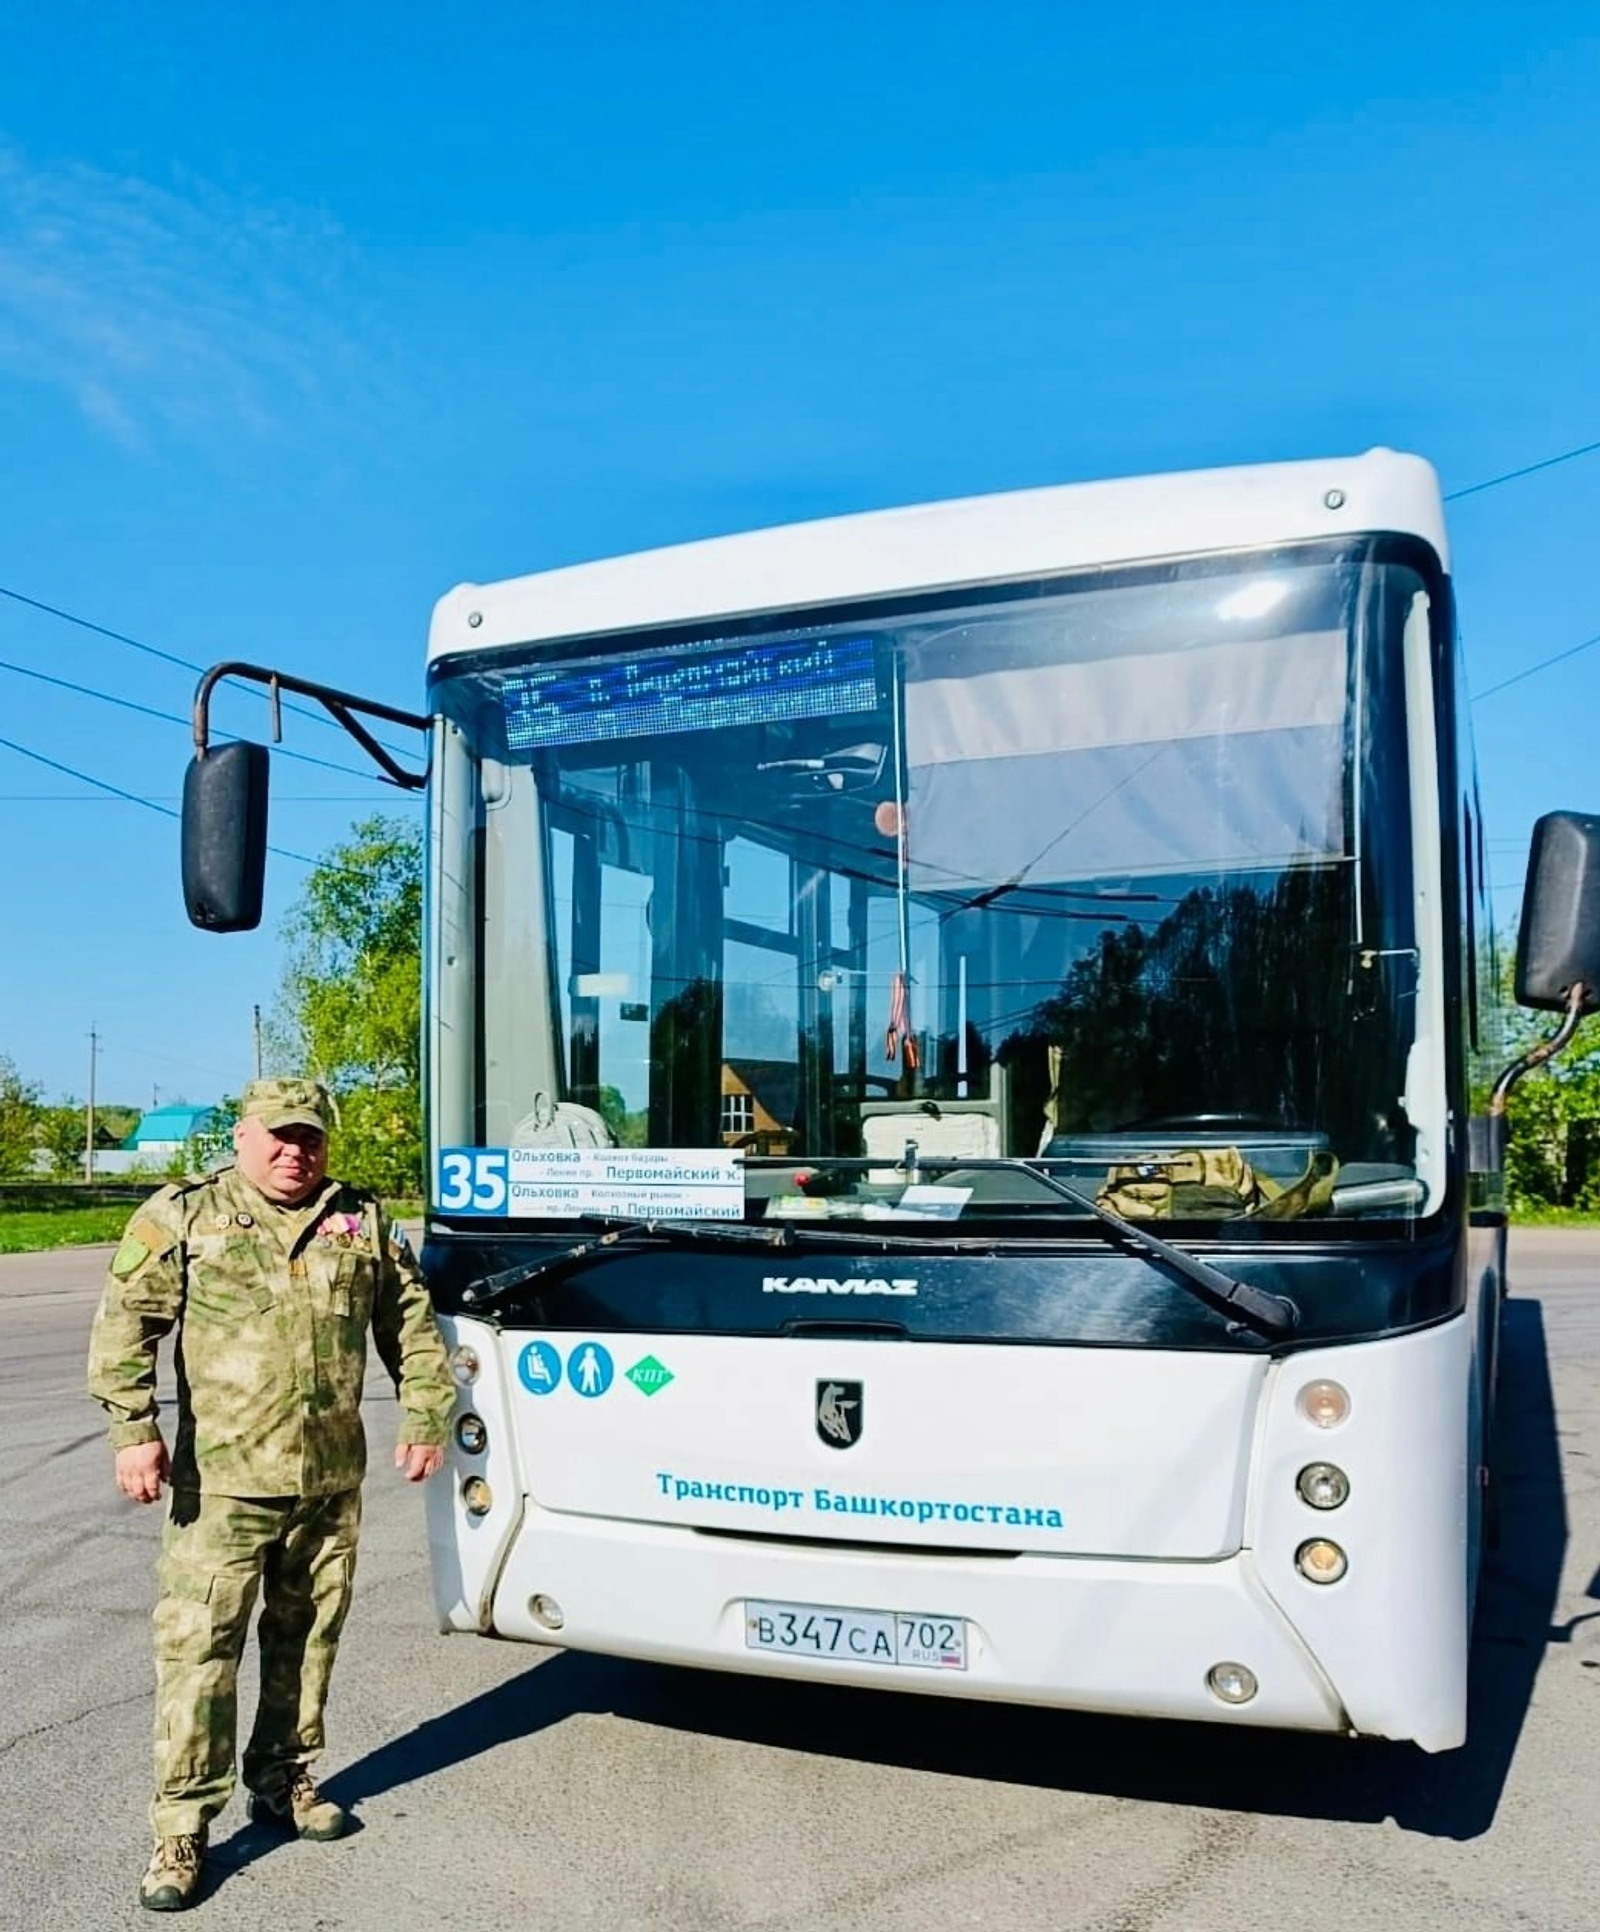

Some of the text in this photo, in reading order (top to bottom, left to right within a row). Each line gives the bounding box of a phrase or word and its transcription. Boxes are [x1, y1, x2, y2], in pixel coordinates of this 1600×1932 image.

[512, 1150, 581, 1163] Ольховка
[607, 1166, 720, 1181] Первомайский
[441, 1154, 506, 1210] 35
[512, 1185, 579, 1198] Ольховка
[628, 1203, 740, 1218] Первомайский
[762, 1277, 918, 1296] KAMAZ
[656, 1473, 1064, 1528] Транспорт Башкортостана
[901, 1620, 955, 1651] 702
[912, 1649, 940, 1662] RUS
